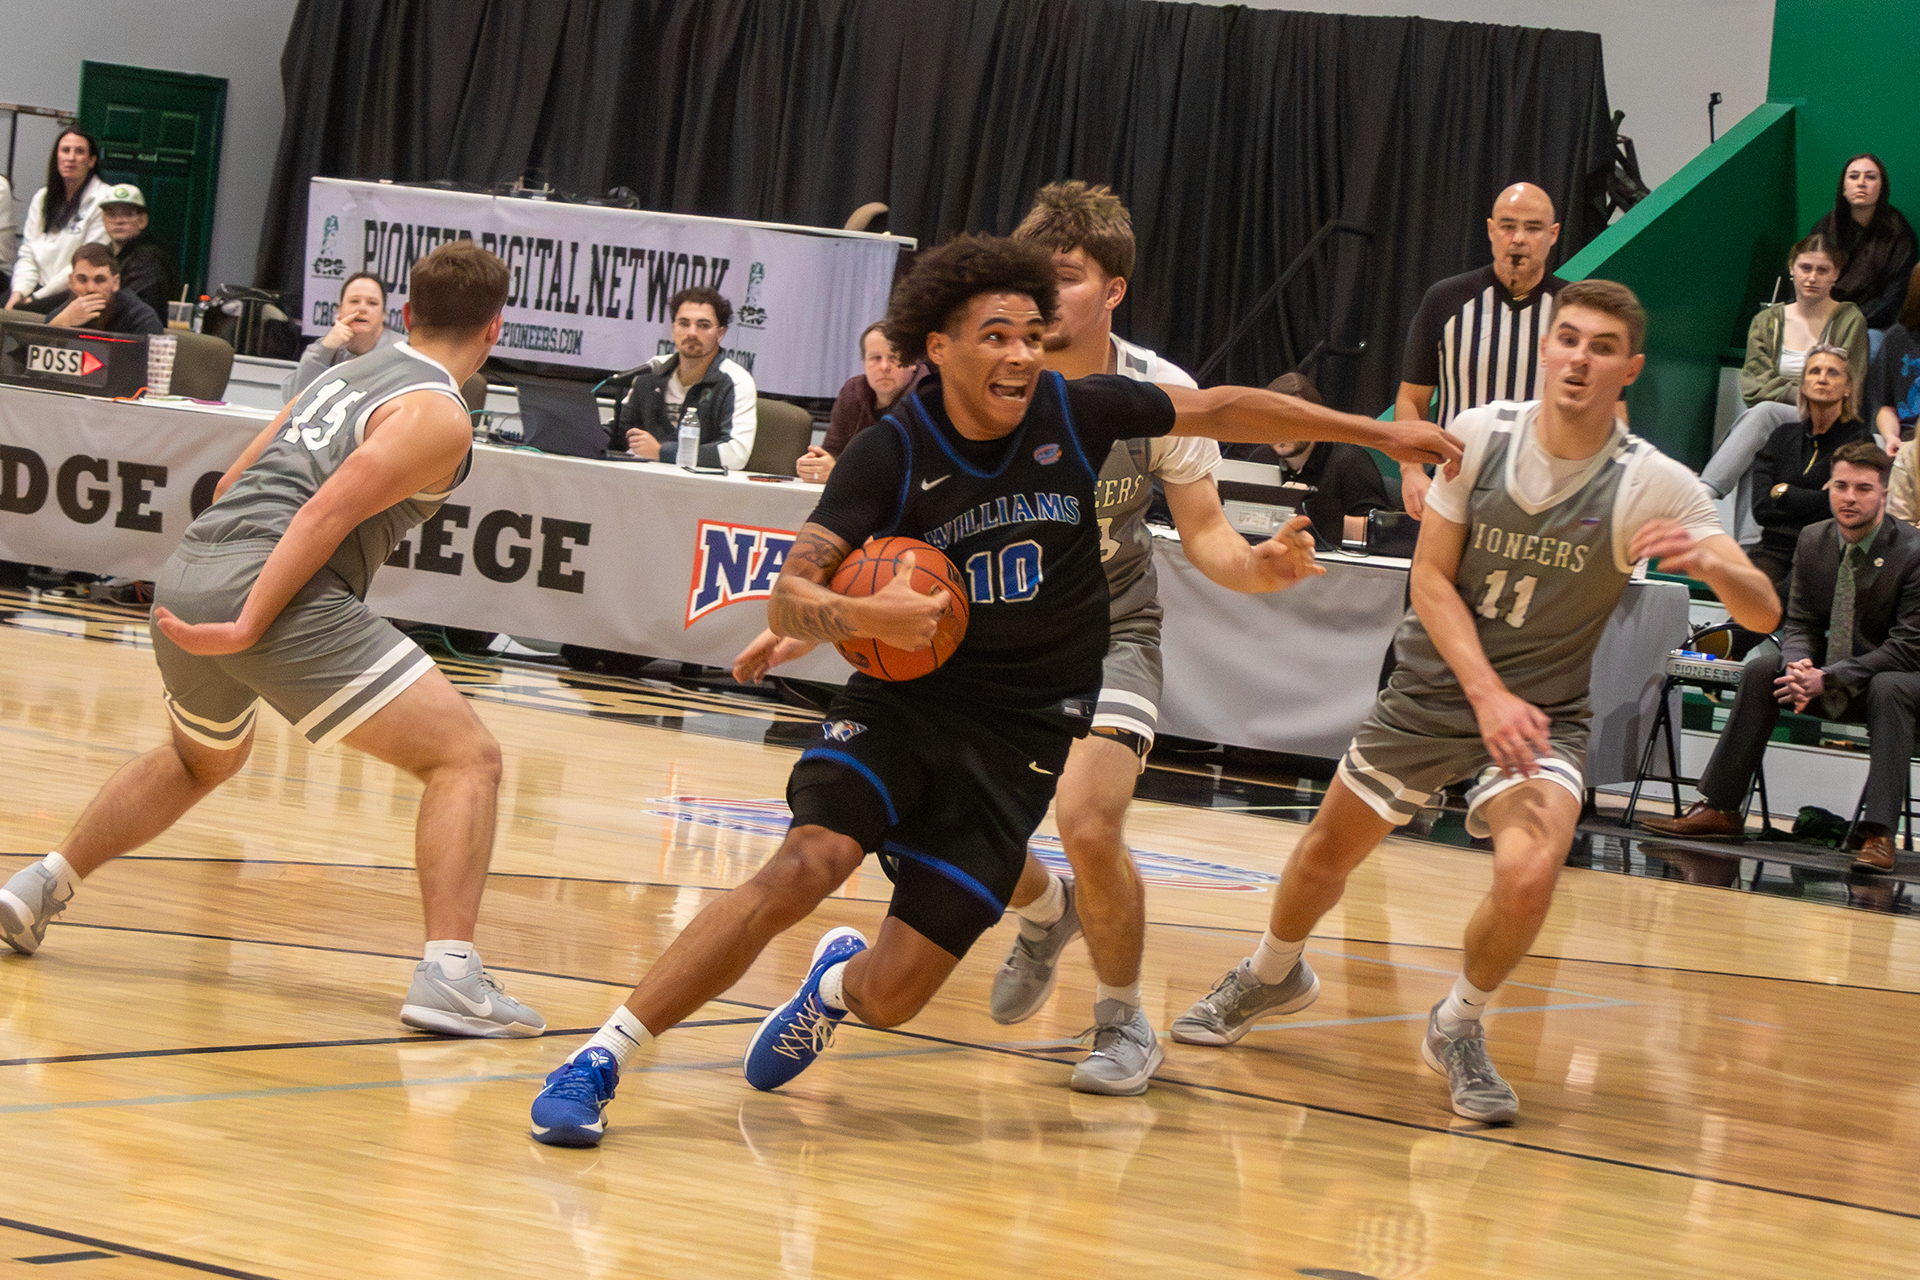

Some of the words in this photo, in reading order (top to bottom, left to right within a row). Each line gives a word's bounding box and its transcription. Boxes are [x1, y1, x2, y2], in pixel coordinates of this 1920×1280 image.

[29, 346, 79, 373] POSS
[283, 377, 368, 451] 15
[924, 492, 1081, 550] WILLIAMS
[1473, 522, 1590, 573] IONEERS
[965, 539, 1044, 604] 10
[1476, 569, 1539, 629] 11
[1673, 663, 1741, 681] PIONEERS
